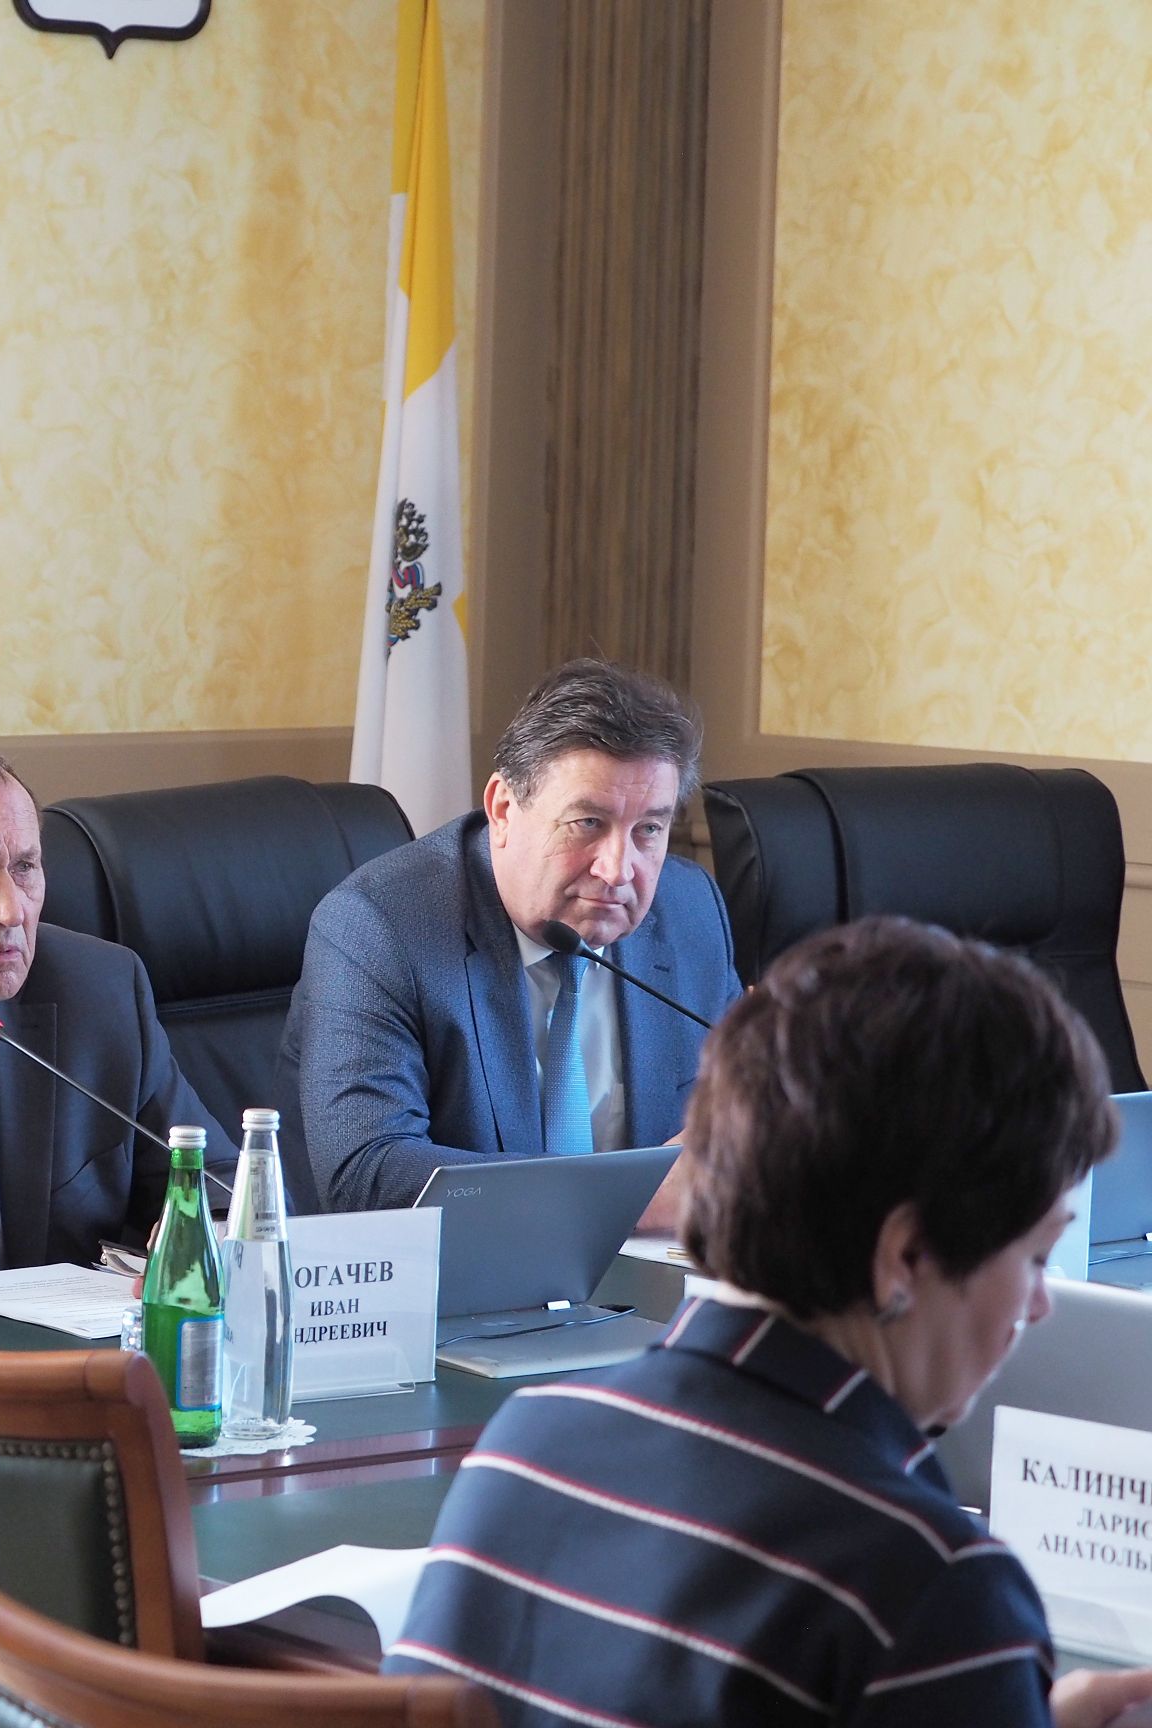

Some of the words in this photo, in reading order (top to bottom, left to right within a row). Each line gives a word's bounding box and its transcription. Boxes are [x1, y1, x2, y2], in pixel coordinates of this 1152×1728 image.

[446, 1186, 482, 1198] YOGA
[294, 1260, 394, 1289] ОГАЧЕВ
[310, 1298, 360, 1318] ИВАН
[294, 1320, 388, 1344] НДРЕЕВИЧ
[1022, 1459, 1152, 1506] КАЛИНЧ
[1077, 1508, 1152, 1540] ЛАРИС
[1038, 1534, 1152, 1572] АНАТОЛЬ
